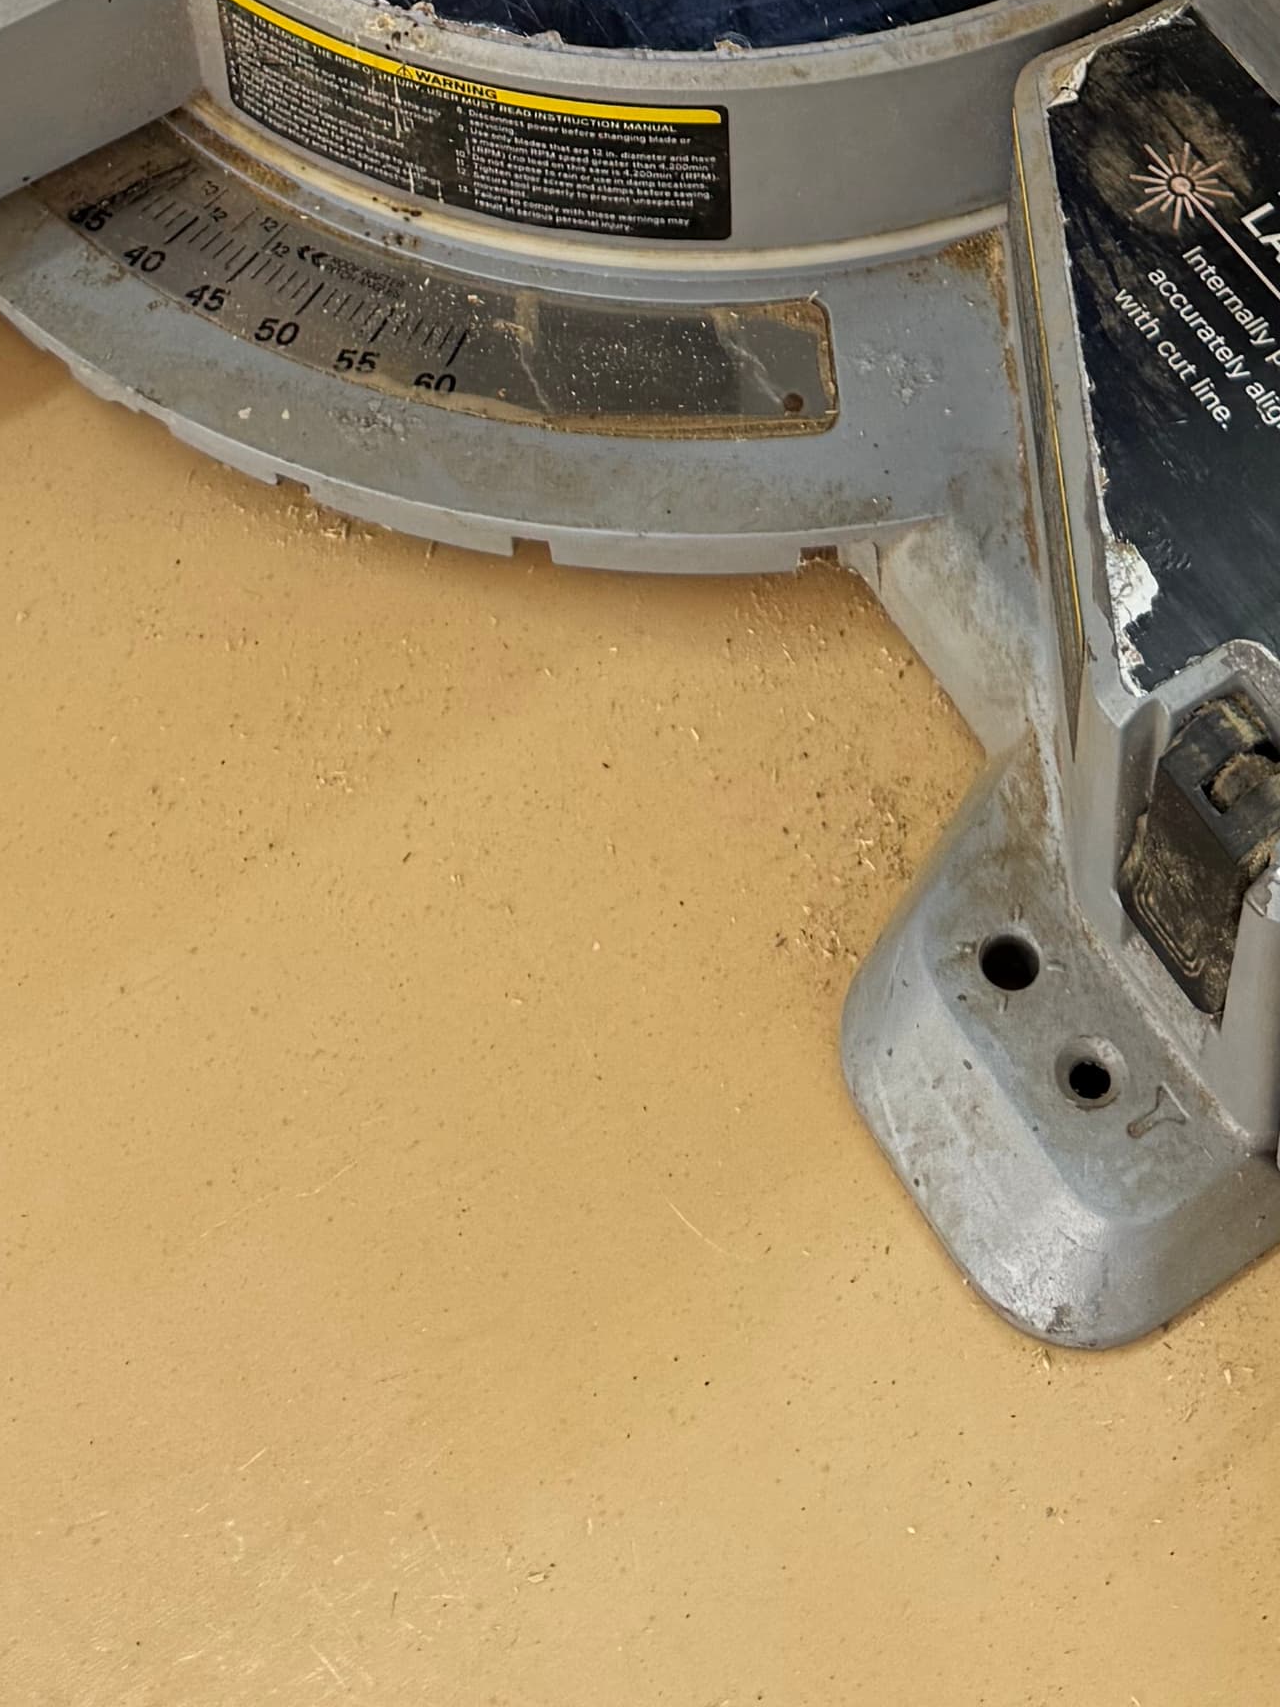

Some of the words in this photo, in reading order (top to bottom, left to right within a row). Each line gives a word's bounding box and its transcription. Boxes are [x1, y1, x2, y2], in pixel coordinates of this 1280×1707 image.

[413, 69, 500, 101] WARNING
[462, 95, 496, 113] MUST
[500, 103, 532, 117] READ
[533, 108, 621, 129] INSTRUCTION
[622, 120, 678, 133] MANUAL
[467, 108, 525, 127] Disconnect
[526, 120, 558, 134] power
[560, 125, 596, 139] before
[597, 129, 646, 144] changing
[648, 133, 677, 146] blade
[619, 148, 666, 164] diameter
[669, 152, 689, 164] and
[690, 153, 716, 165] have
[124, 244, 166, 273] 40
[185, 283, 226, 313] 45
[254, 317, 300, 347] 50
[333, 348, 381, 374] 55
[1148, 267, 1251, 381] accurately
[1181, 244, 1276, 348] Internally
[1114, 288, 1160, 342] with
[1156, 339, 1198, 381] cut
[1189, 377, 1232, 431] line.
